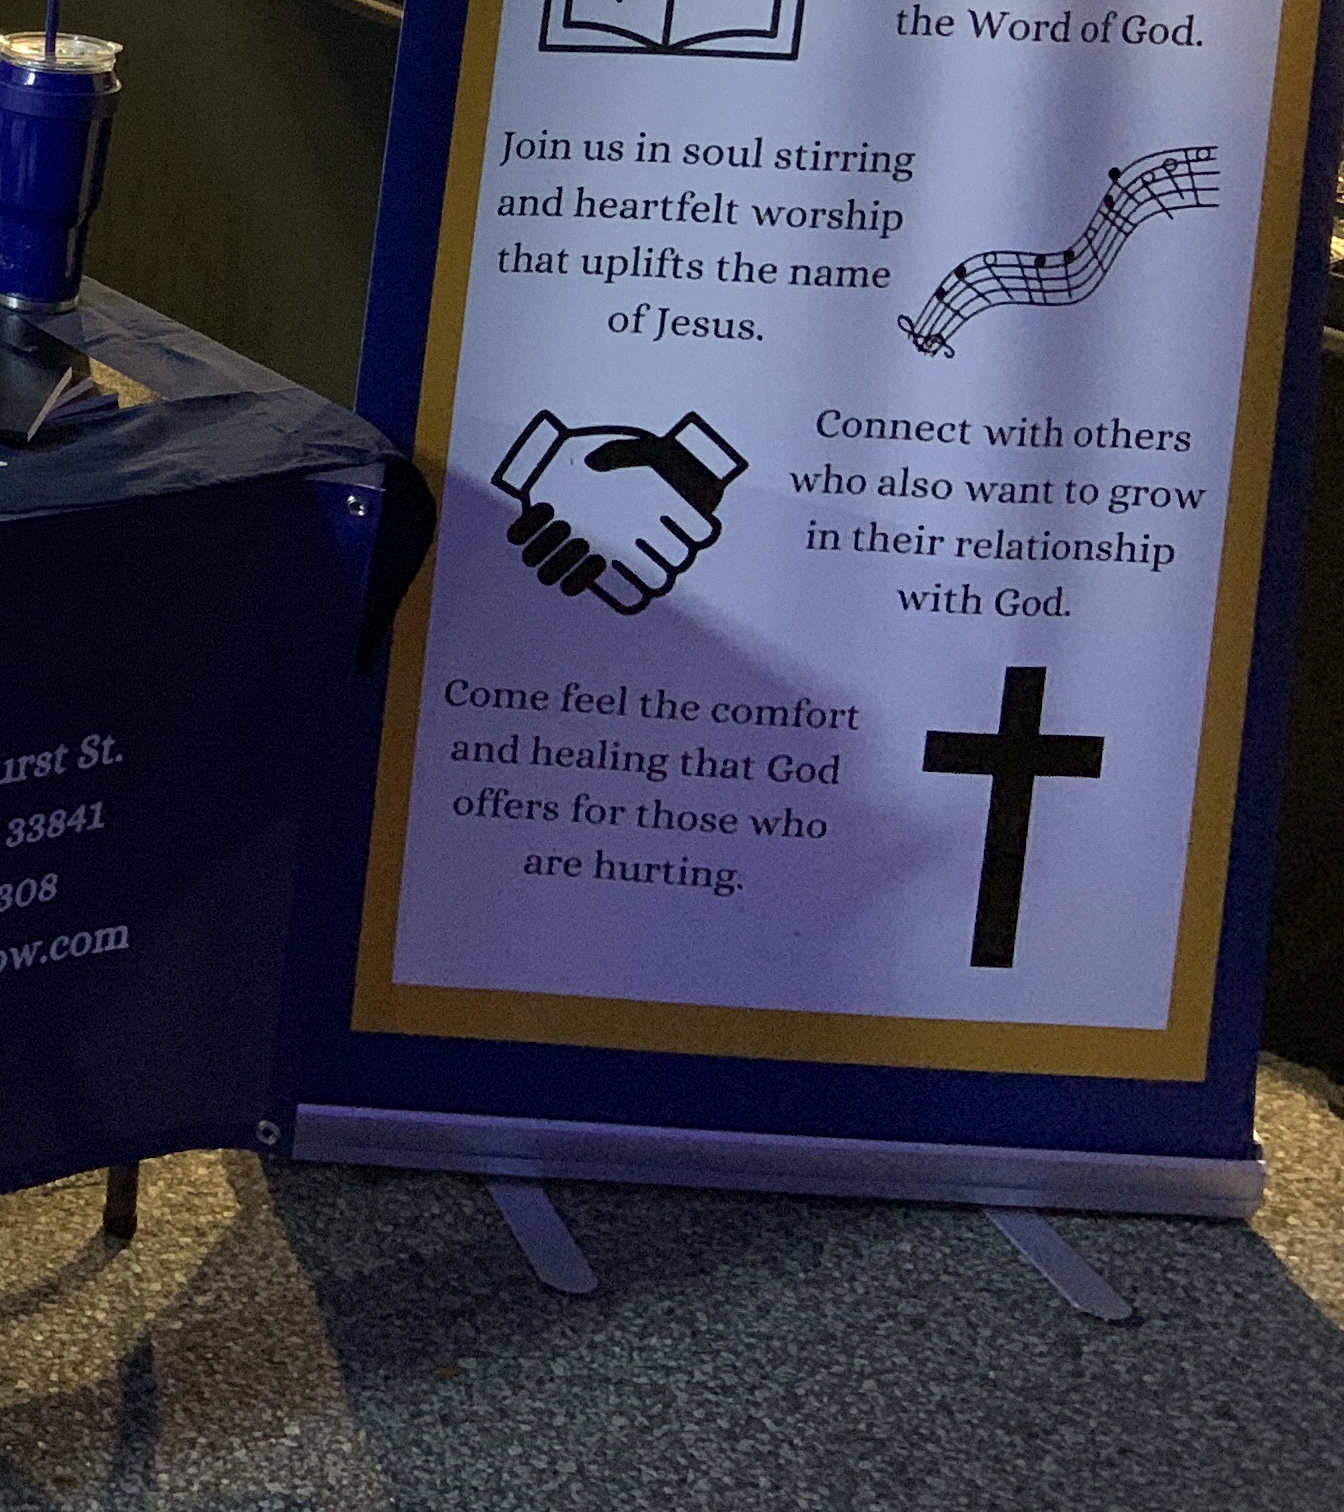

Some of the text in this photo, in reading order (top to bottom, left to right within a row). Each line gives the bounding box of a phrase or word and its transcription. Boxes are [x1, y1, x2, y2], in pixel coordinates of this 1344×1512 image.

[897, 8, 1202, 46] the Word of God.
[500, 130, 915, 182] Join us in soul stirring
[498, 186, 903, 239] and heartfelt worship
[499, 242, 890, 288] that uplifts the name
[608, 303, 763, 341] of Jesus.
[817, 410, 1190, 452] Connect with others
[790, 463, 1206, 514] who also want to grow
[807, 520, 1174, 572] in their relationship
[898, 583, 1070, 616] with God.
[445, 679, 859, 730] Come feel the comfort
[78, 734, 123, 769] St.
[451, 734, 839, 784] and healing that God
[6, 801, 104, 847] 33841
[453, 788, 827, 838] offers for those who
[524, 850, 742, 896] are hurting.
